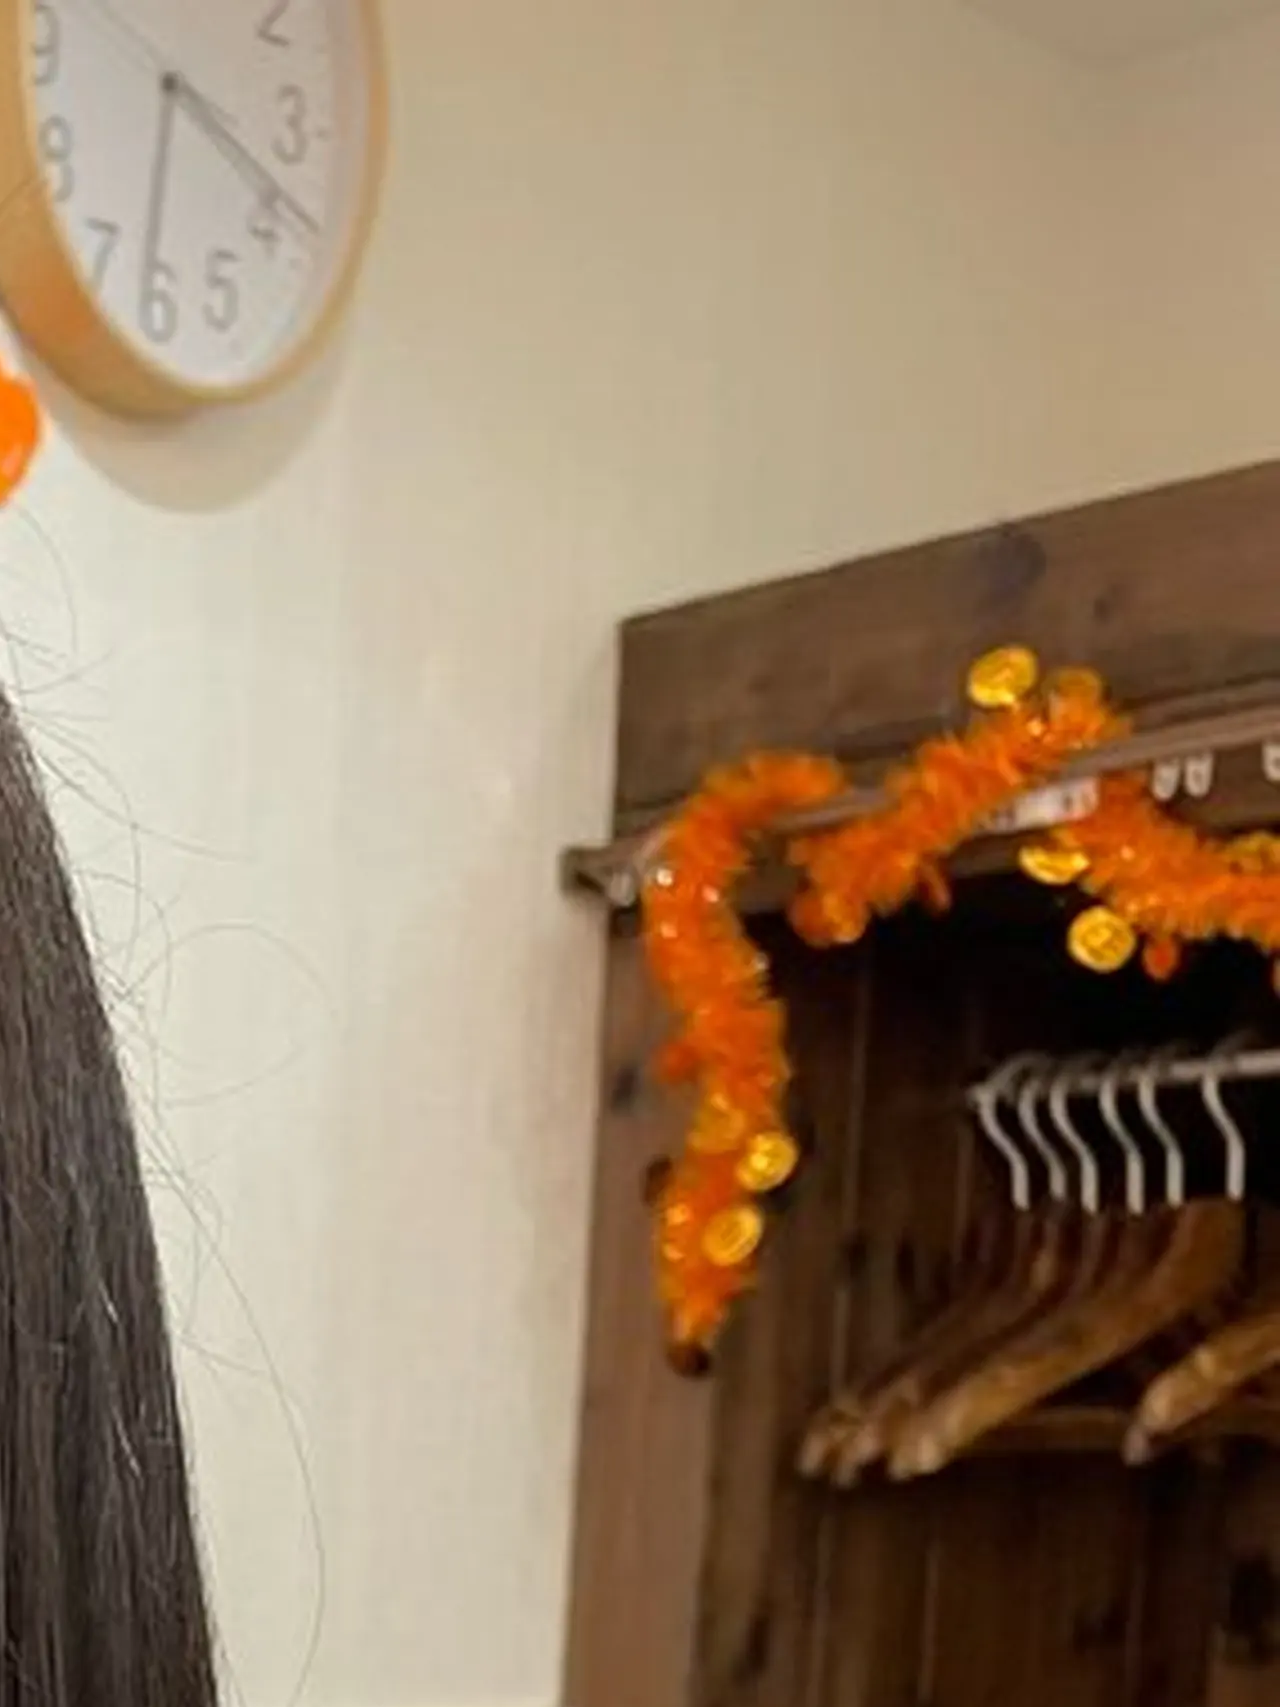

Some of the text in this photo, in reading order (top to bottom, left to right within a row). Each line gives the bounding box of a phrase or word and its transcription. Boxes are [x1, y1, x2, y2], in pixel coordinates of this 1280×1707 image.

[39, 115, 76, 203] 8
[270, 84, 309, 166] 3
[85, 217, 120, 292] 7
[201, 249, 241, 332] 5
[138, 260, 180, 344] 6
